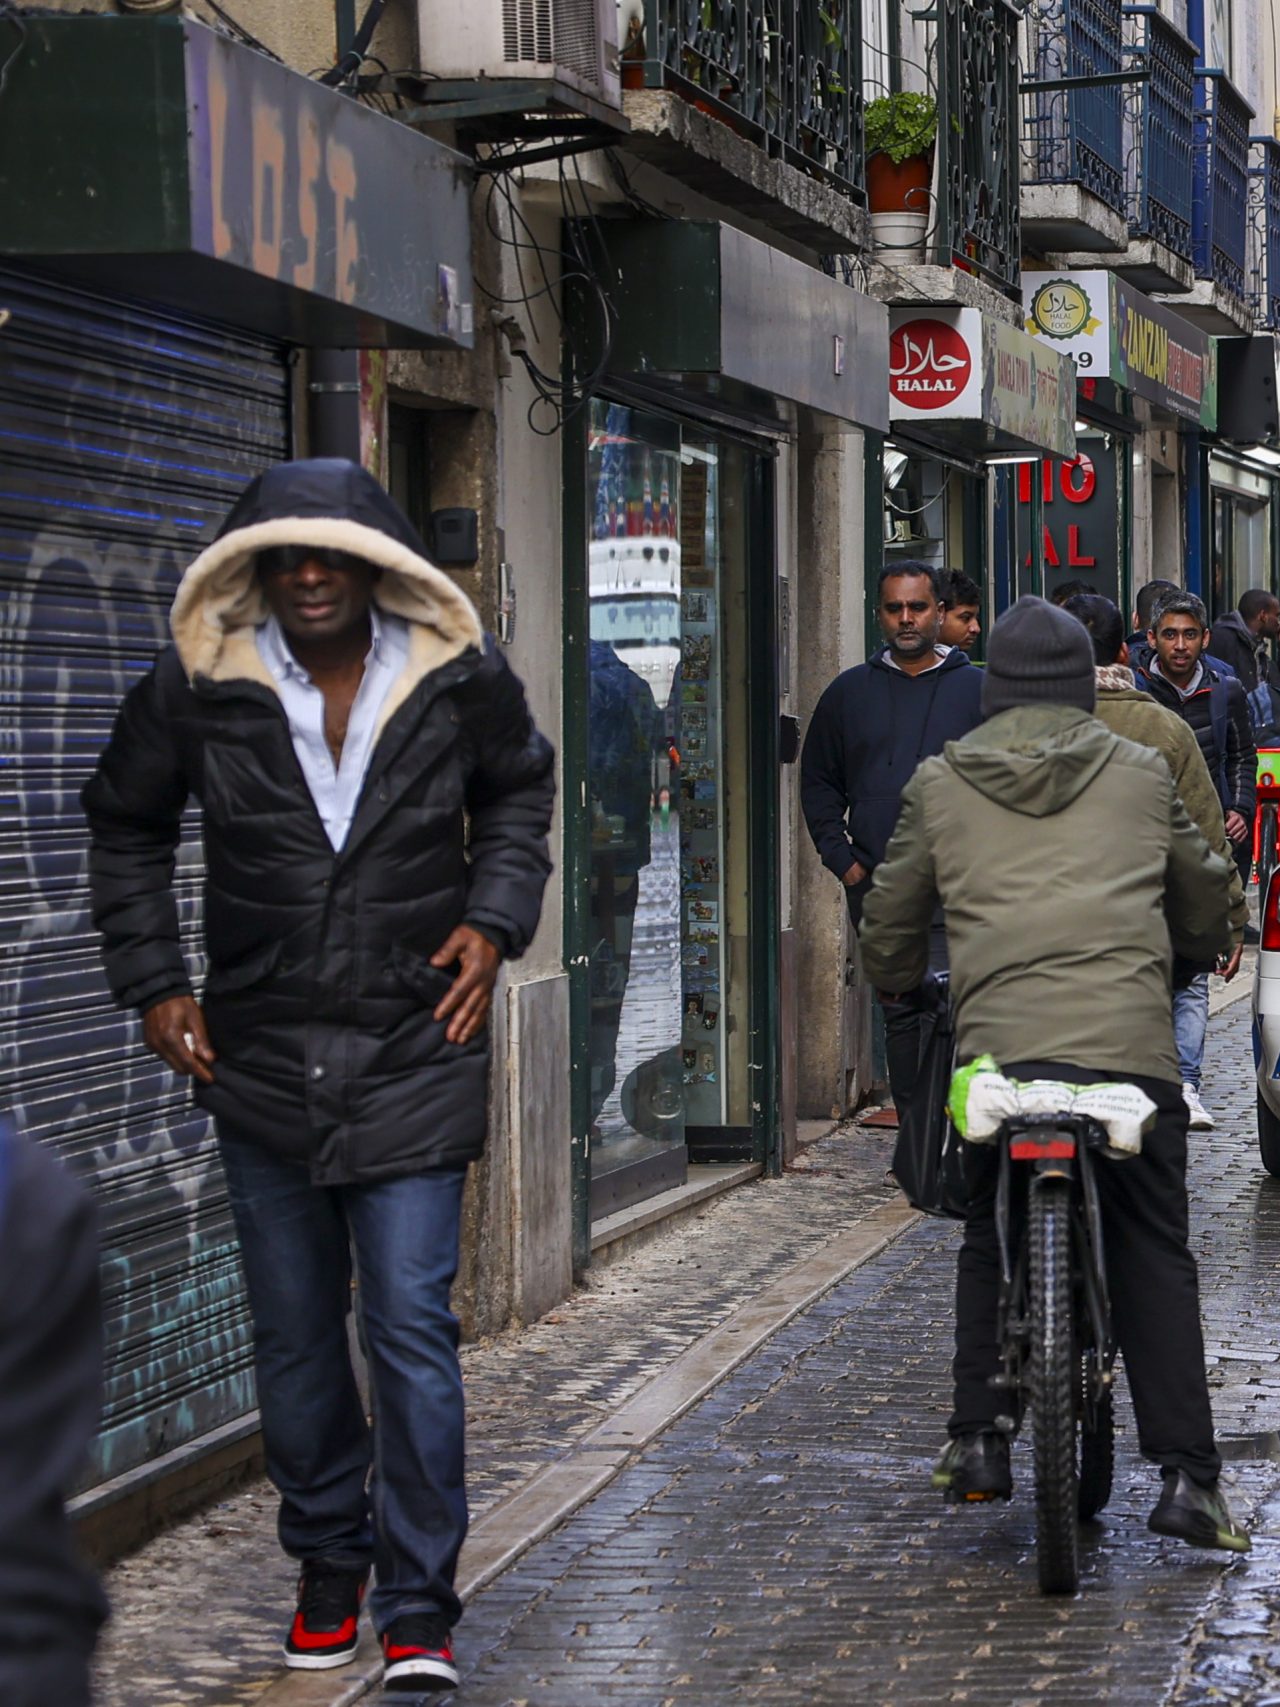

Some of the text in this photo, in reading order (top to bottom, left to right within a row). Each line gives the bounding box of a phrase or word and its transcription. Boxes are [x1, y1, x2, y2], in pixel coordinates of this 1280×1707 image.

[1050, 312, 1072, 320] HALAL
[1050, 321, 1072, 329] FOOD
[1127, 306, 1168, 387] ZAMZAM
[890, 332, 967, 376] حلال
[1065, 351, 1093, 368] 9
[897, 379, 957, 391] HALAL
